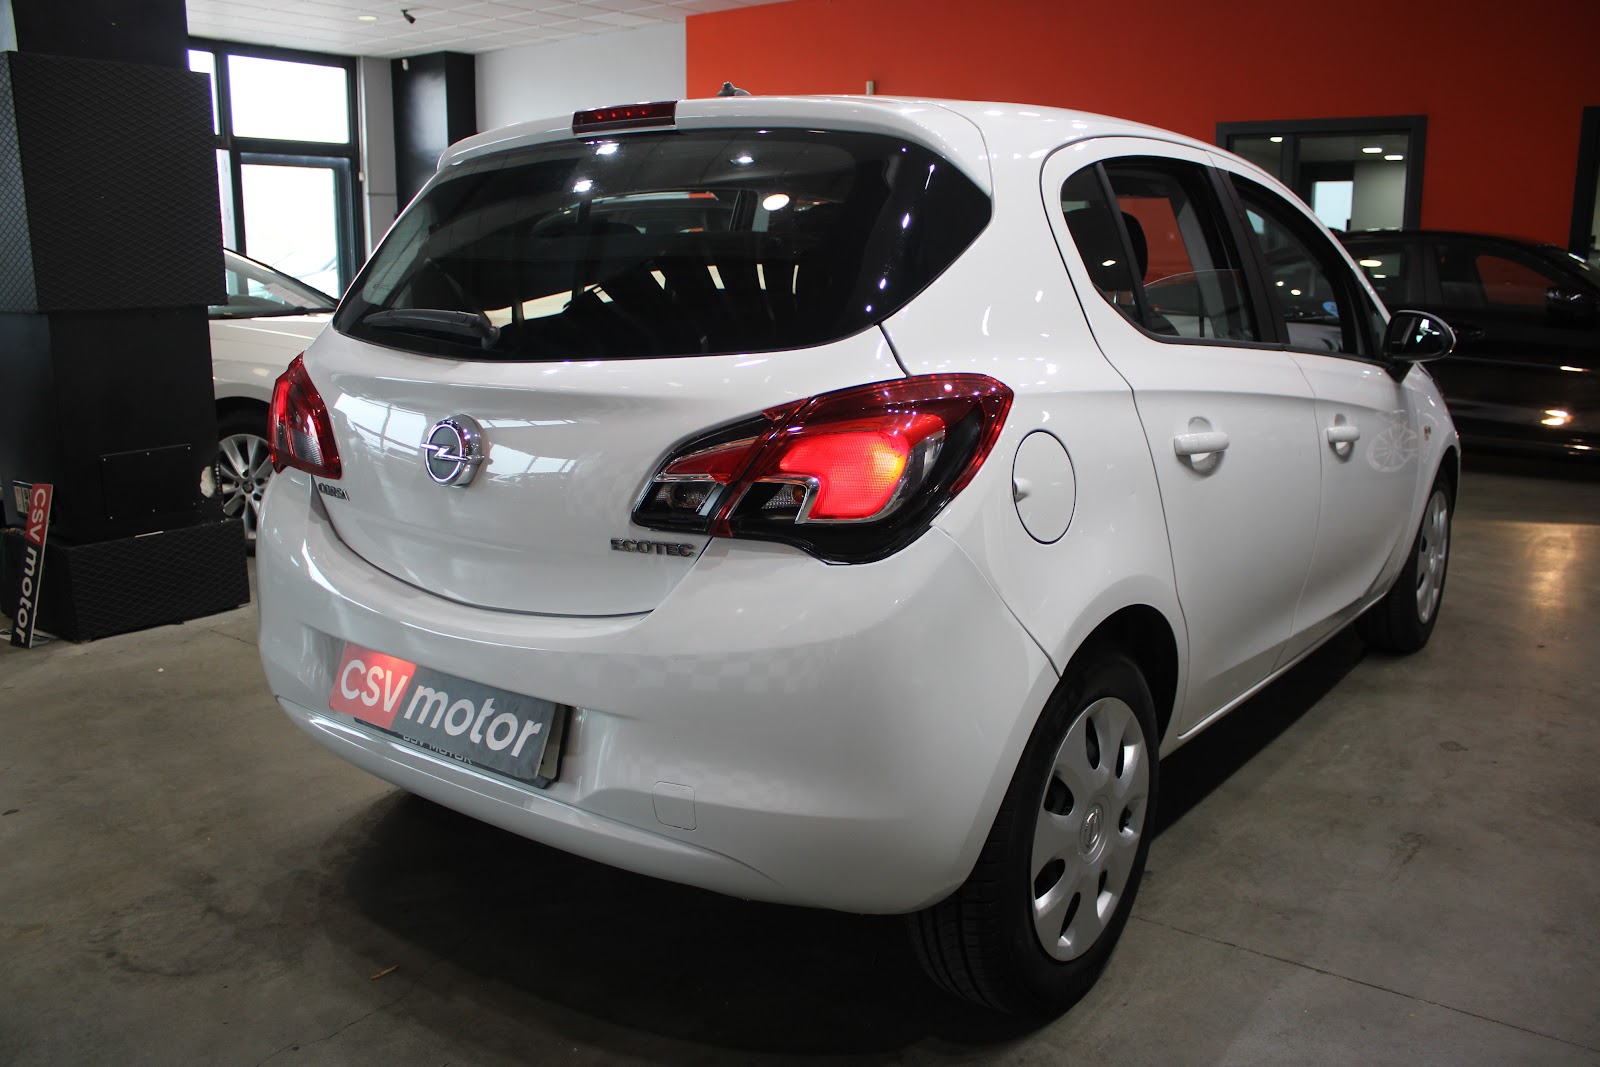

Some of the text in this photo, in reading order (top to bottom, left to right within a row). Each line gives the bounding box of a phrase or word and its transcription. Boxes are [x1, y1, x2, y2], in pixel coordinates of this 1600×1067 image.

[15, 488, 47, 644] CSV motor
[610, 537, 695, 557] ECOTEC
[340, 659, 543, 758] CSV motor
